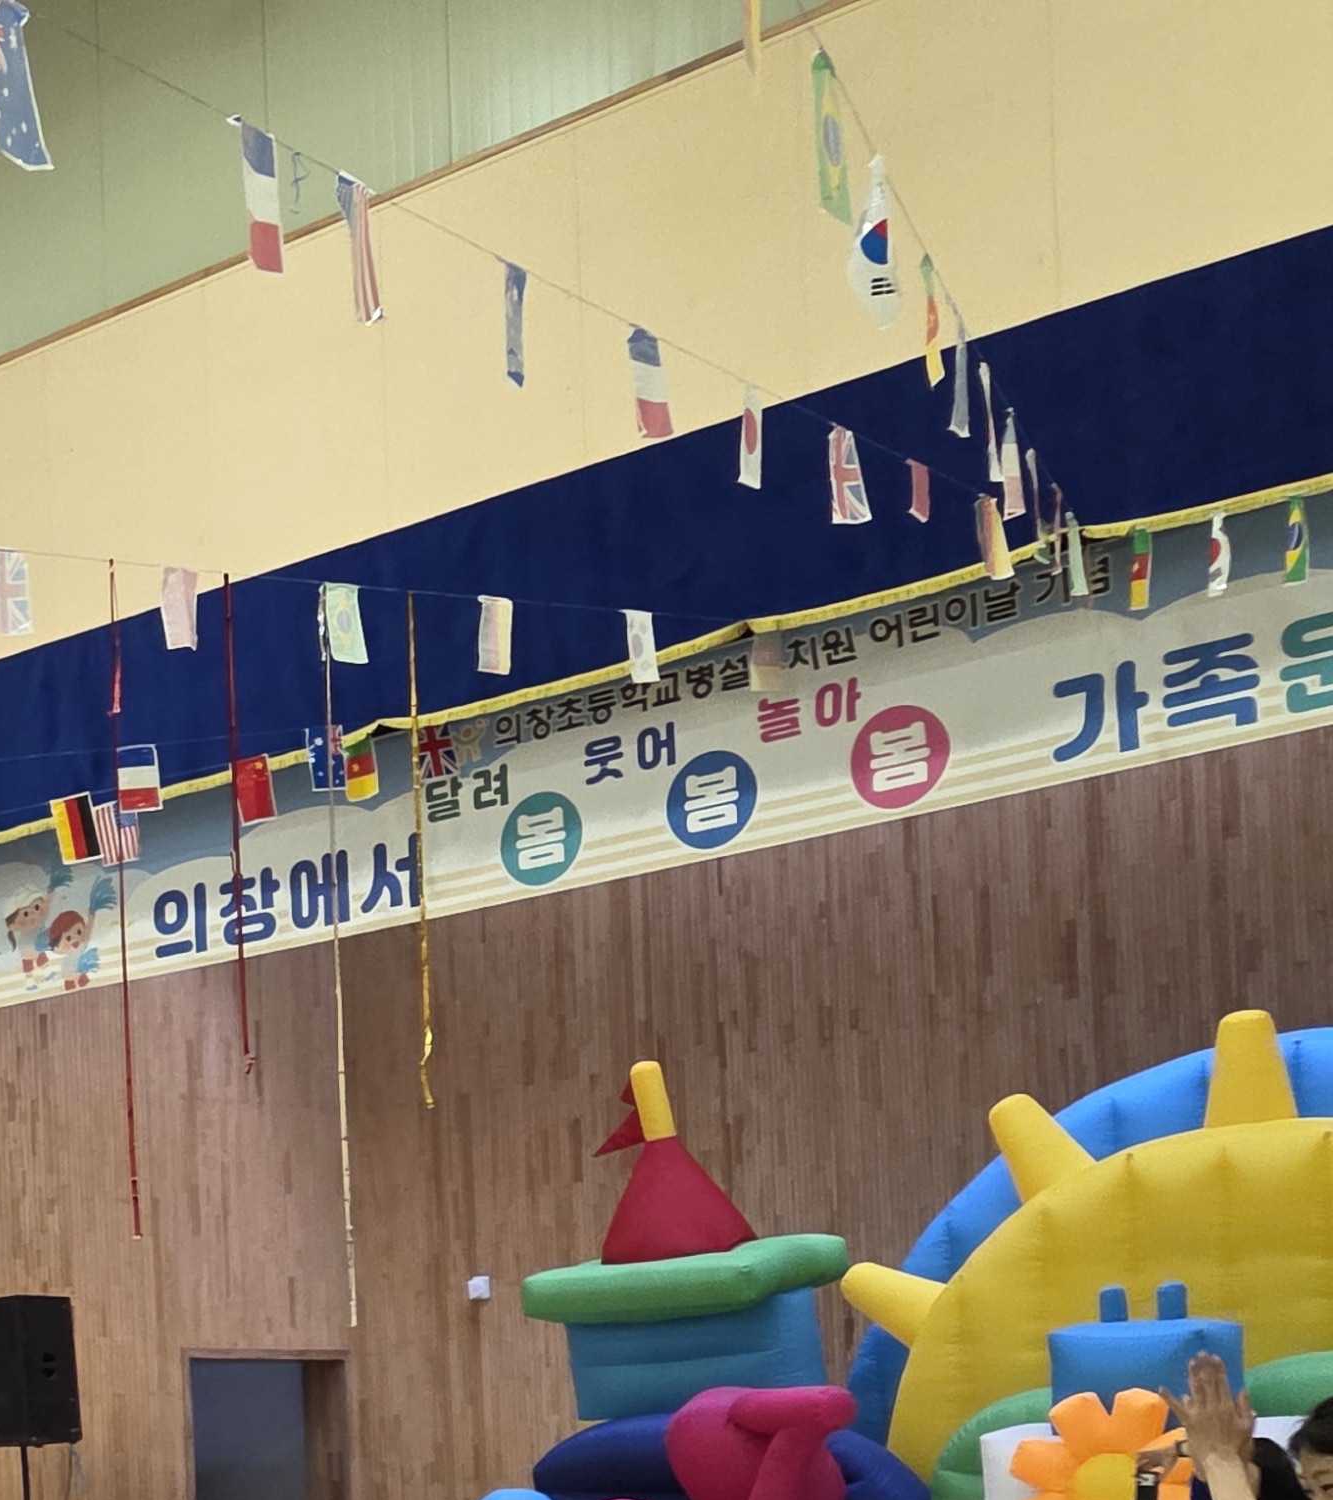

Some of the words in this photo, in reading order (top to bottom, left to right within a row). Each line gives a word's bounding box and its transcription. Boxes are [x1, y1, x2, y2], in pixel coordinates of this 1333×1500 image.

[494, 625, 859, 745] 의창초등학교병설치원
[868, 582, 1022, 648] 어린이날
[153, 831, 421, 959] 의창에서
[425, 762, 510, 824] 달려
[514, 805, 567, 871] 봄
[583, 720, 677, 786] 웃어
[683, 765, 740, 834] 봄
[756, 676, 862, 744] 놀아
[868, 720, 932, 794] 봄
